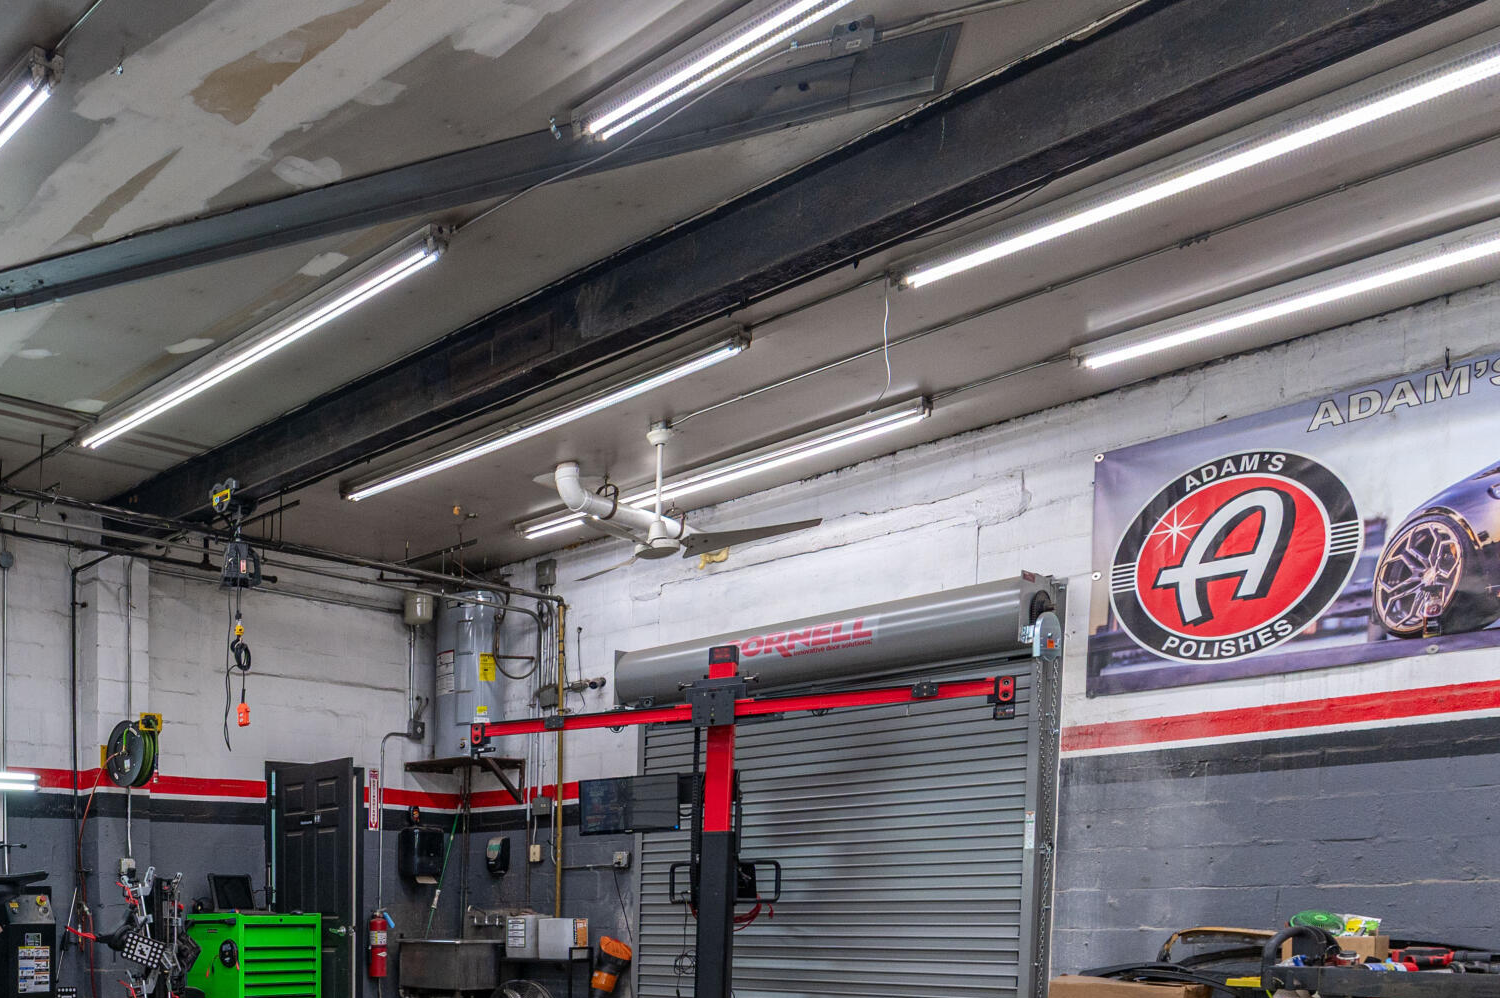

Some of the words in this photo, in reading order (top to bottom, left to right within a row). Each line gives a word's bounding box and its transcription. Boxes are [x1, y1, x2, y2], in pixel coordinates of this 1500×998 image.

[1184, 453, 1288, 493] ADAM'S
[826, 644, 841, 652] door
[1163, 618, 1294, 661] POLISHES
